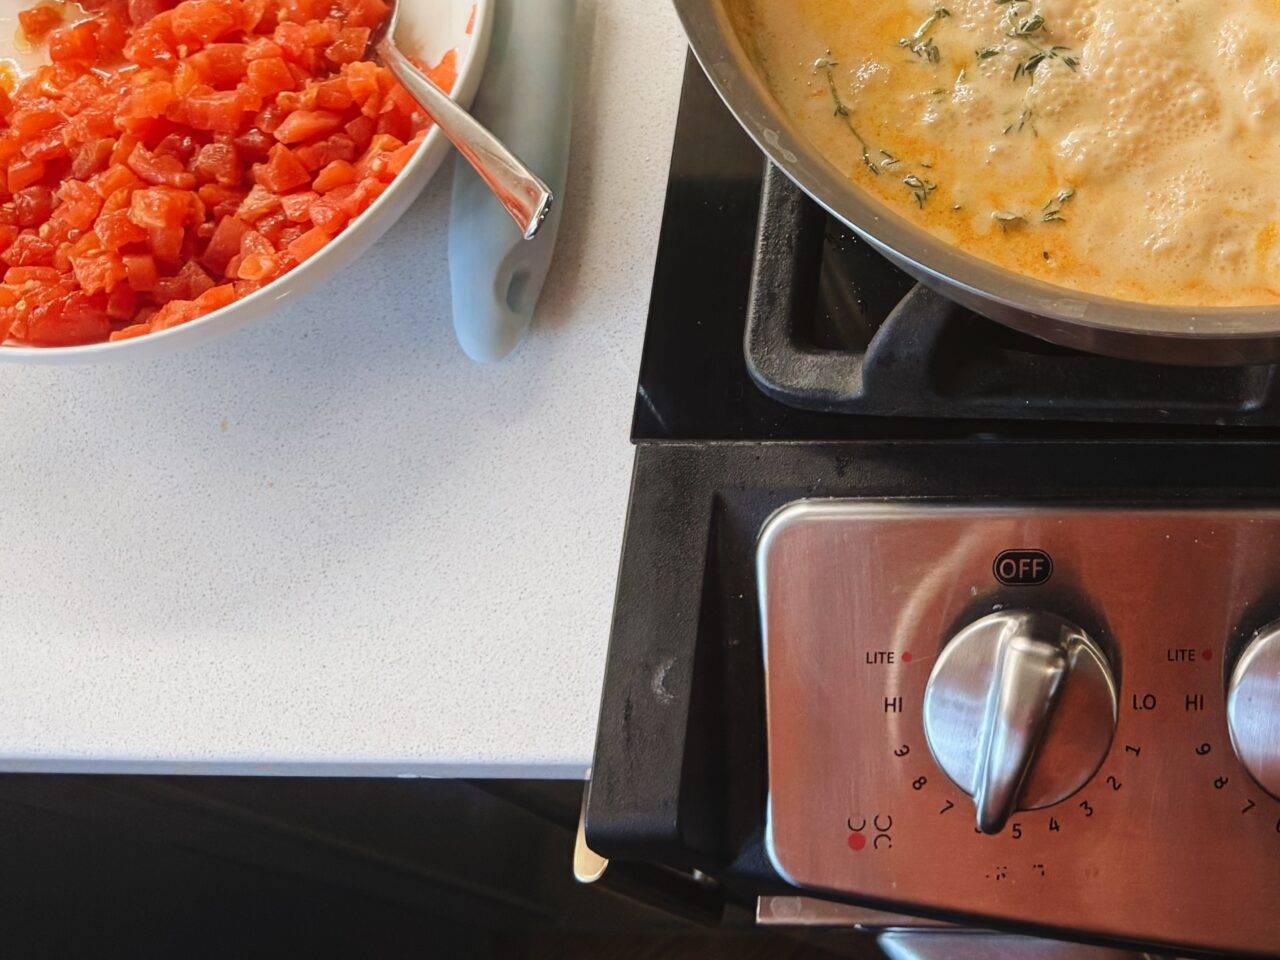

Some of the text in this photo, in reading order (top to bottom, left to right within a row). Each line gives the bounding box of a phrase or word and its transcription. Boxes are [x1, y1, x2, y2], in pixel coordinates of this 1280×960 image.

[1000, 559, 1044, 579] OFF
[866, 651, 895, 664] LITE
[1167, 649, 1196, 662] LITE
[884, 698, 903, 713] HI
[1185, 695, 1204, 711] HI
[1125, 744, 1141, 757] 1
[1195, 743, 1211, 755] 9
[912, 776, 927, 790] 8
[1107, 775, 1122, 791] 2
[940, 799, 954, 814] 7
[1079, 800, 1094, 817] 3
[1241, 798, 1256, 814] 7
[1012, 823, 1022, 839] 5
[1049, 816, 1060, 833] 4
